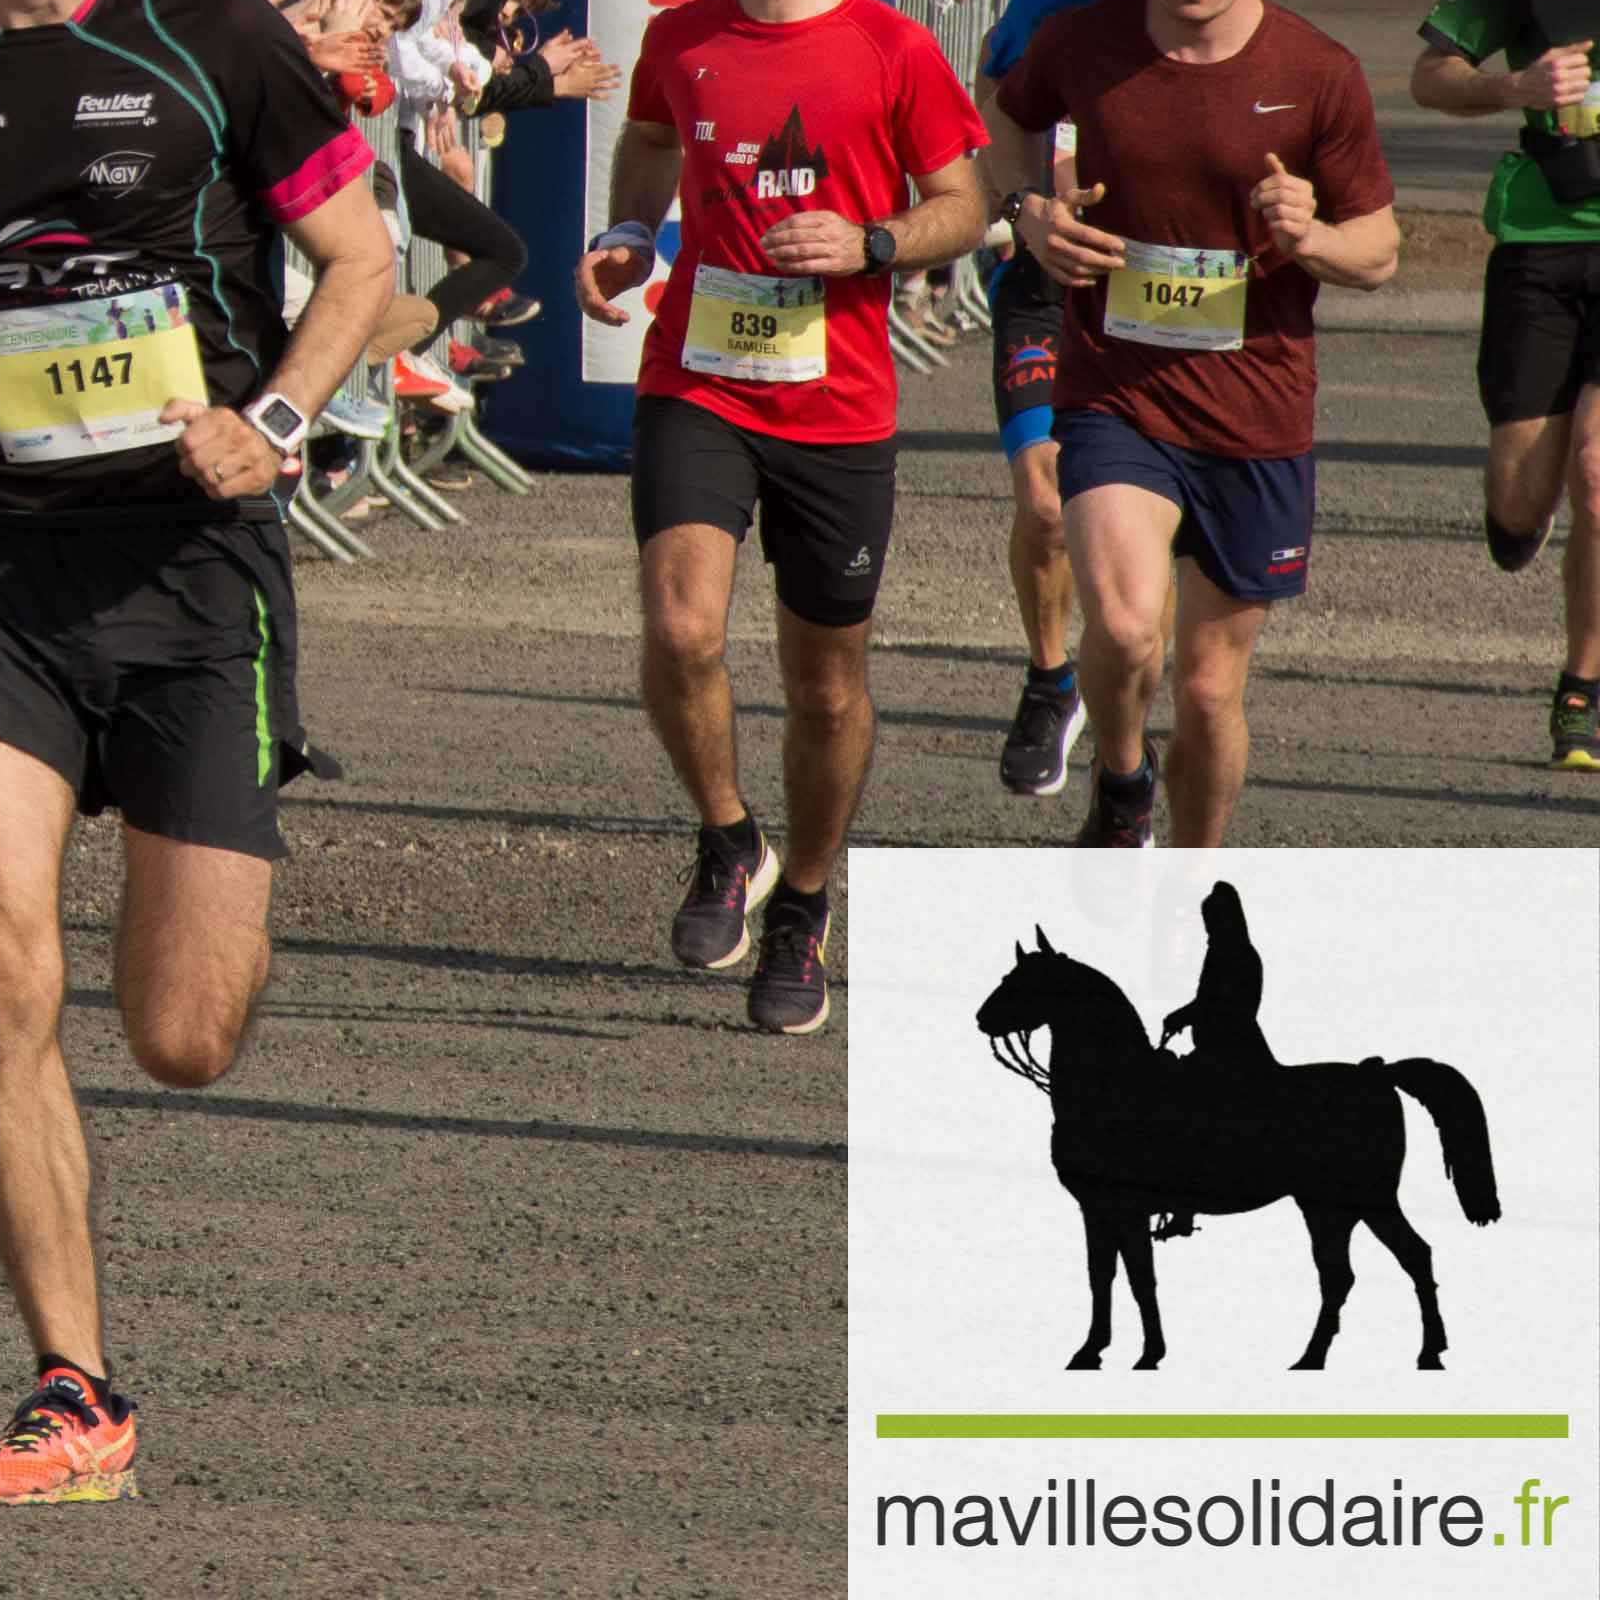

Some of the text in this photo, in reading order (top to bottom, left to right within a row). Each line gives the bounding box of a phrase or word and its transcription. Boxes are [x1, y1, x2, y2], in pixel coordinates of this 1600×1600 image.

[757, 168, 816, 199] RAID
[1142, 281, 1204, 307] 1047
[731, 311, 778, 338] 839
[727, 339, 780, 355] SAMUEL
[44, 351, 134, 395] 1147
